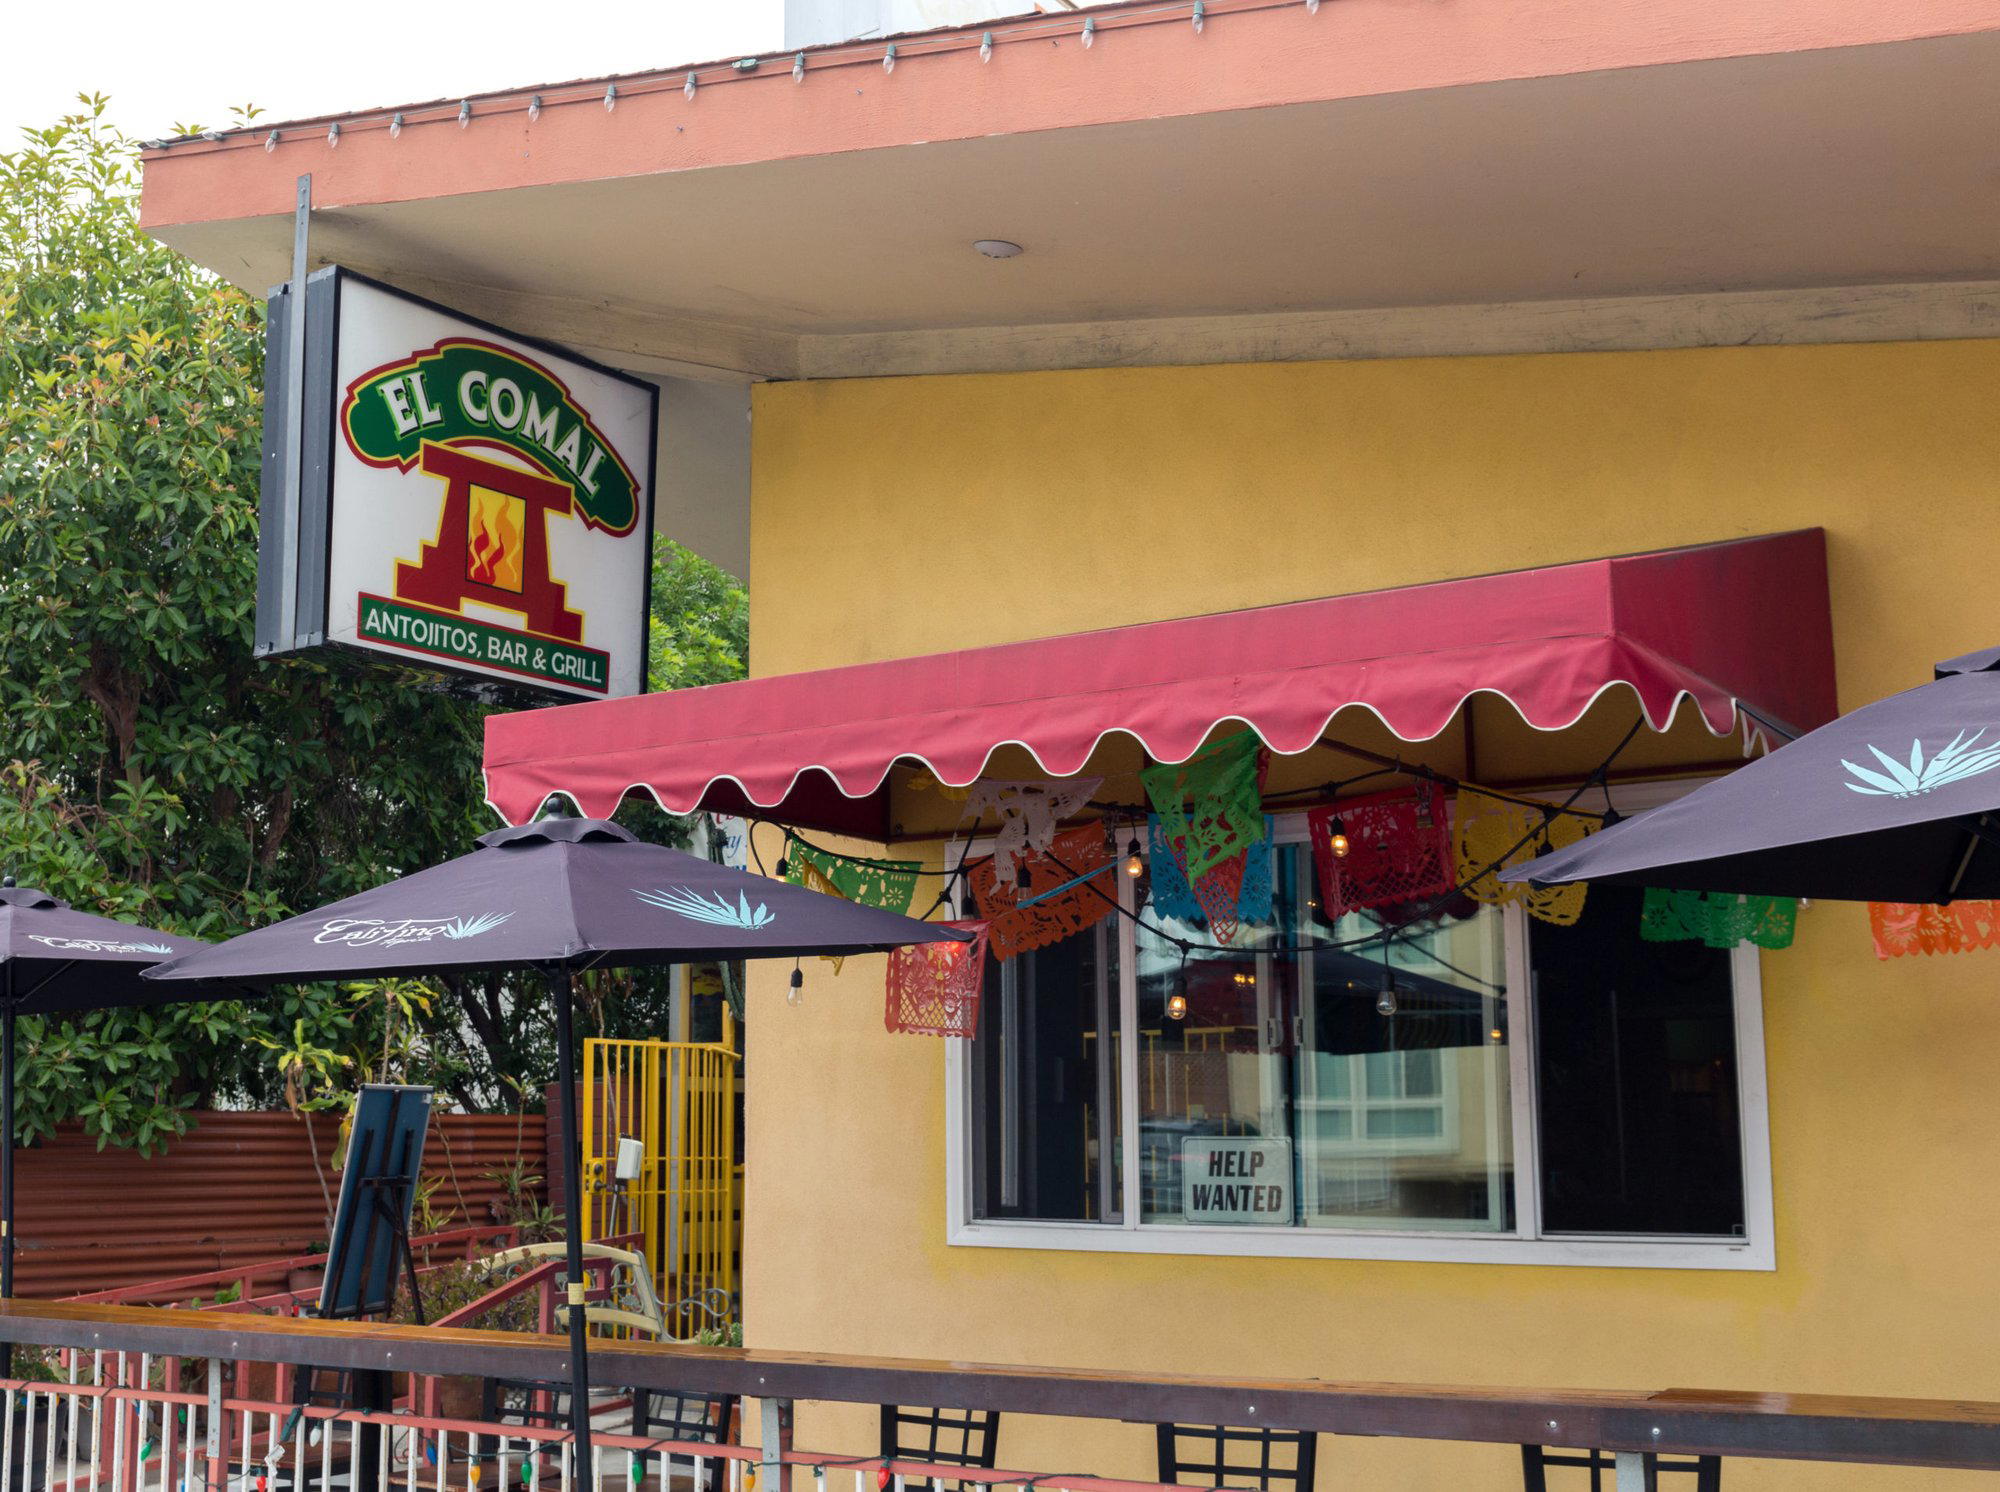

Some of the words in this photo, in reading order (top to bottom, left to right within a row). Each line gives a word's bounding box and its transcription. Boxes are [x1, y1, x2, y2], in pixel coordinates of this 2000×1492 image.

[380, 371, 444, 437] EL
[459, 370, 607, 497] COMAL
[364, 607, 482, 658] ANTOJITOS,
[487, 635, 528, 666] BAR
[532, 647, 546, 671] &
[550, 652, 602, 683] GRILL
[1208, 1150, 1265, 1177] HELP
[1192, 1184, 1283, 1212] WANTED
